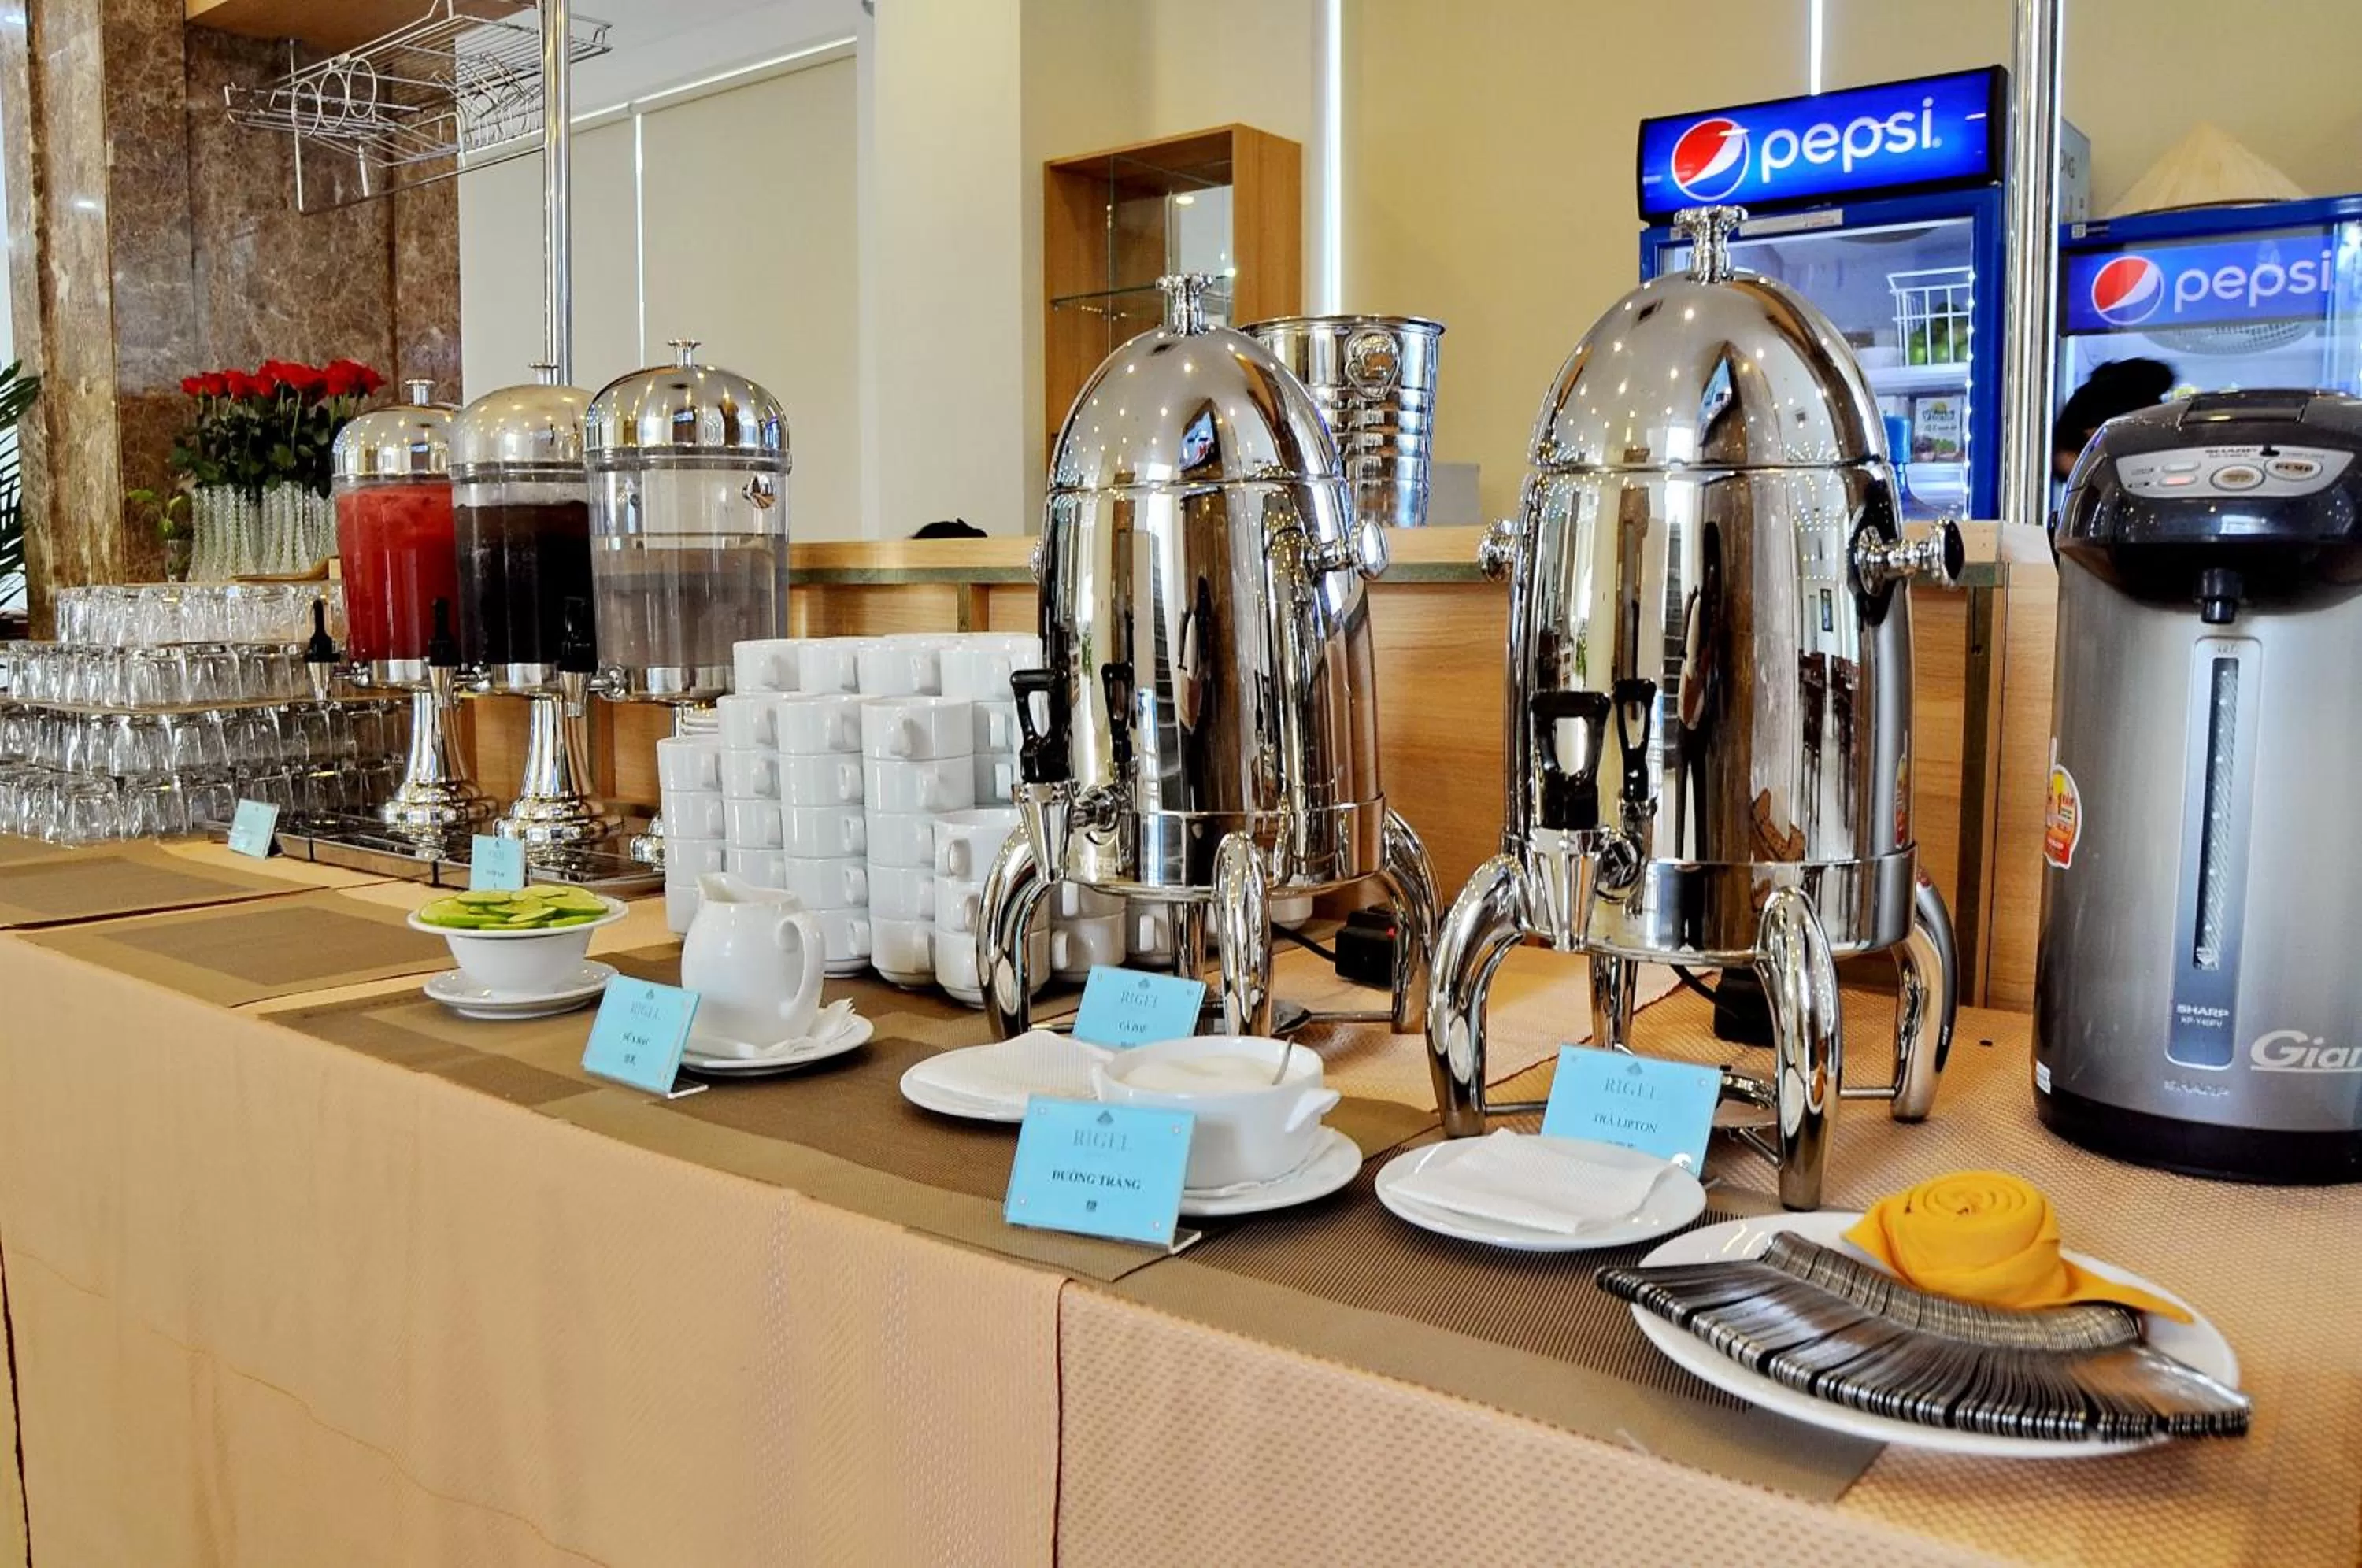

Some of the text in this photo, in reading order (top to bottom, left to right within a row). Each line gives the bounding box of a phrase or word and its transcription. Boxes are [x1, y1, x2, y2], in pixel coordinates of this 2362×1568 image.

[1761, 97, 1934, 183] pepsi
[2174, 249, 2332, 313] pepsi
[2176, 1004, 2230, 1019] SHARP
